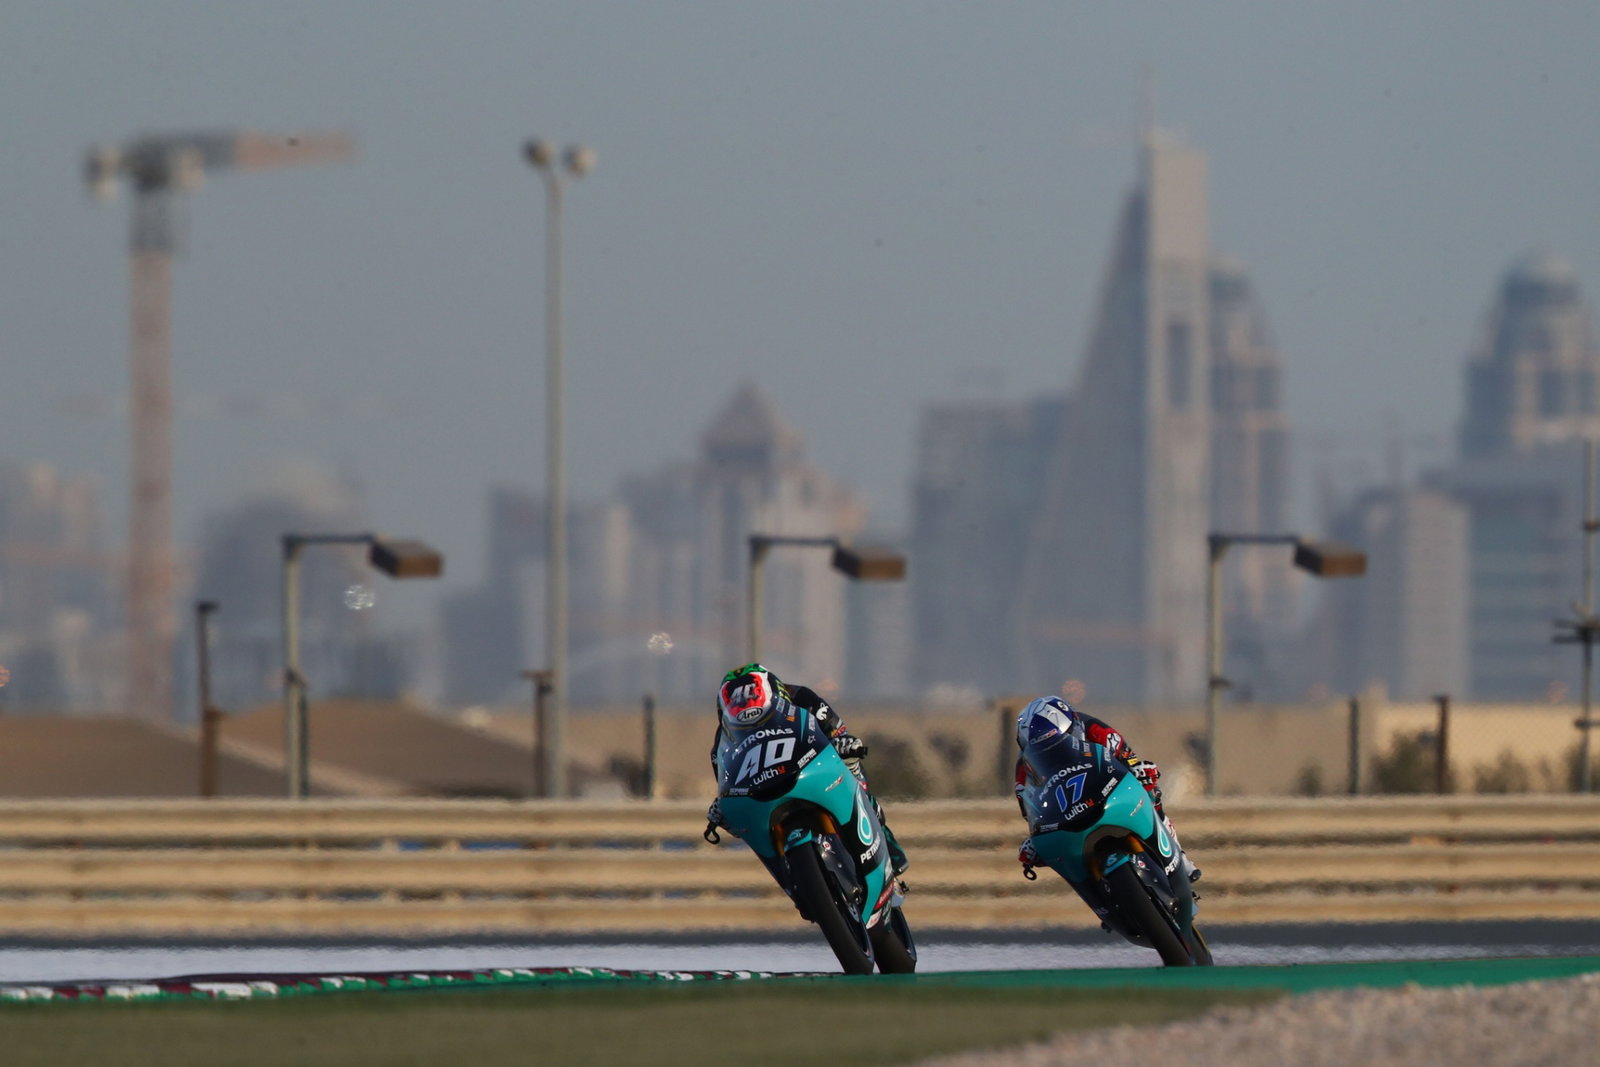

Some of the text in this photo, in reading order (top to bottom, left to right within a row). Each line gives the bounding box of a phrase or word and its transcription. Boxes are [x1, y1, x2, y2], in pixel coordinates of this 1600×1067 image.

[740, 708, 760, 721] Arai
[734, 737, 796, 785] 40
[1055, 772, 1087, 813] 17
